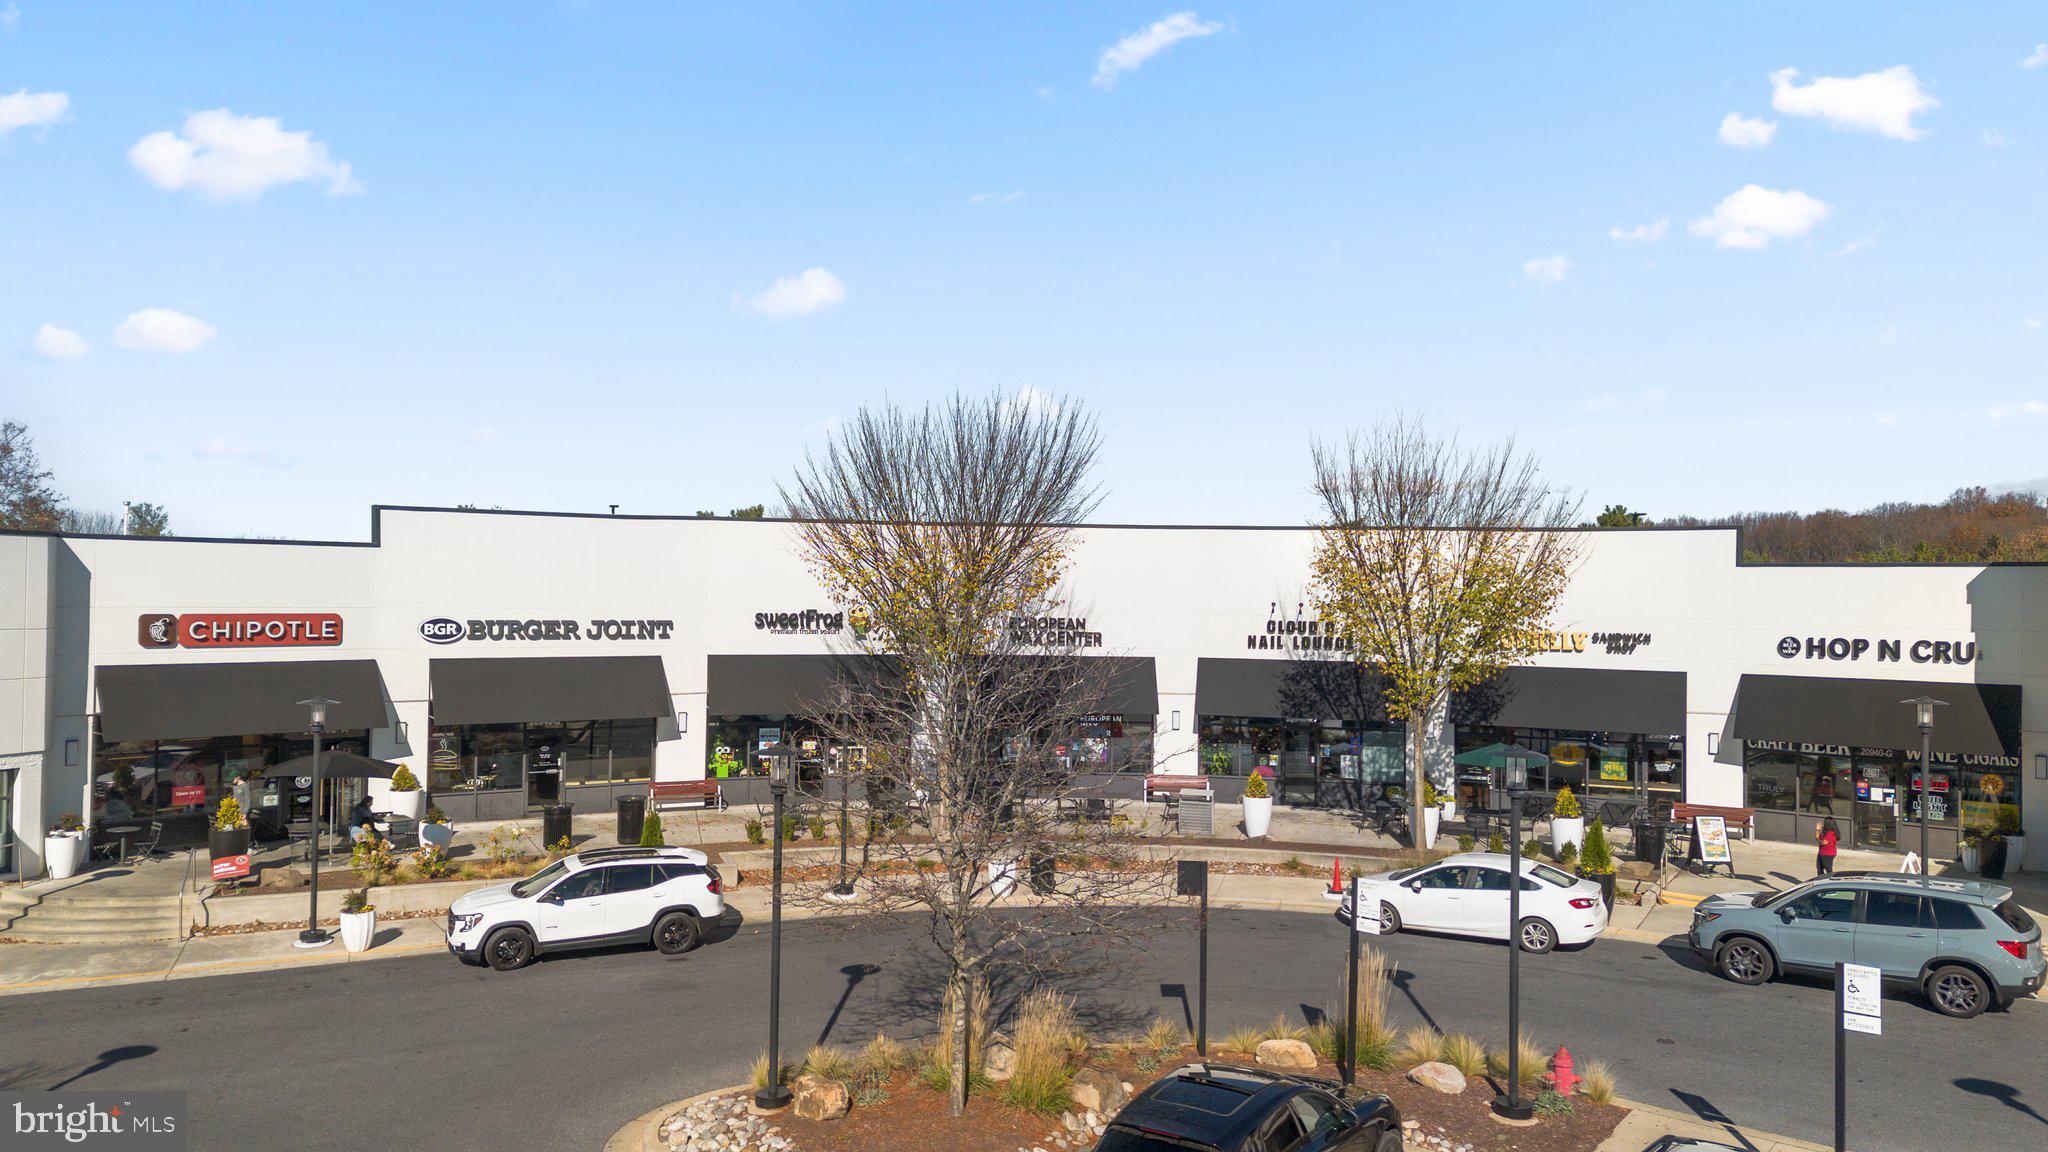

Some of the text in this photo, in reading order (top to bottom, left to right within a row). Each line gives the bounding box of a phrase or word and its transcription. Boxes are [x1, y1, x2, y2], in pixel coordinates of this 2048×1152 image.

[755, 609, 844, 630] sweetFrog
[1009, 617, 1086, 631] EUROPEAN
[189, 620, 336, 641] CHIPOTLE
[423, 622, 458, 636] BGR
[466, 620, 674, 640] BURGER JOINT
[1266, 620, 1318, 635] CLOUD
[1046, 631, 1102, 647] CENTER
[1247, 635, 1284, 650] NAIL
[1591, 632, 1652, 646] SANDWICH
[1606, 643, 1637, 655] SHOP
[1805, 637, 1869, 660] HOP
[1877, 639, 1901, 662] N
[1800, 743, 1851, 756] BEER
[1860, 747, 1893, 757] 20940-G
[1906, 750, 2020, 767] WNE CIGARS
[1757, 783, 1785, 792] TRULY
[213, 866, 237, 874] HIRING
